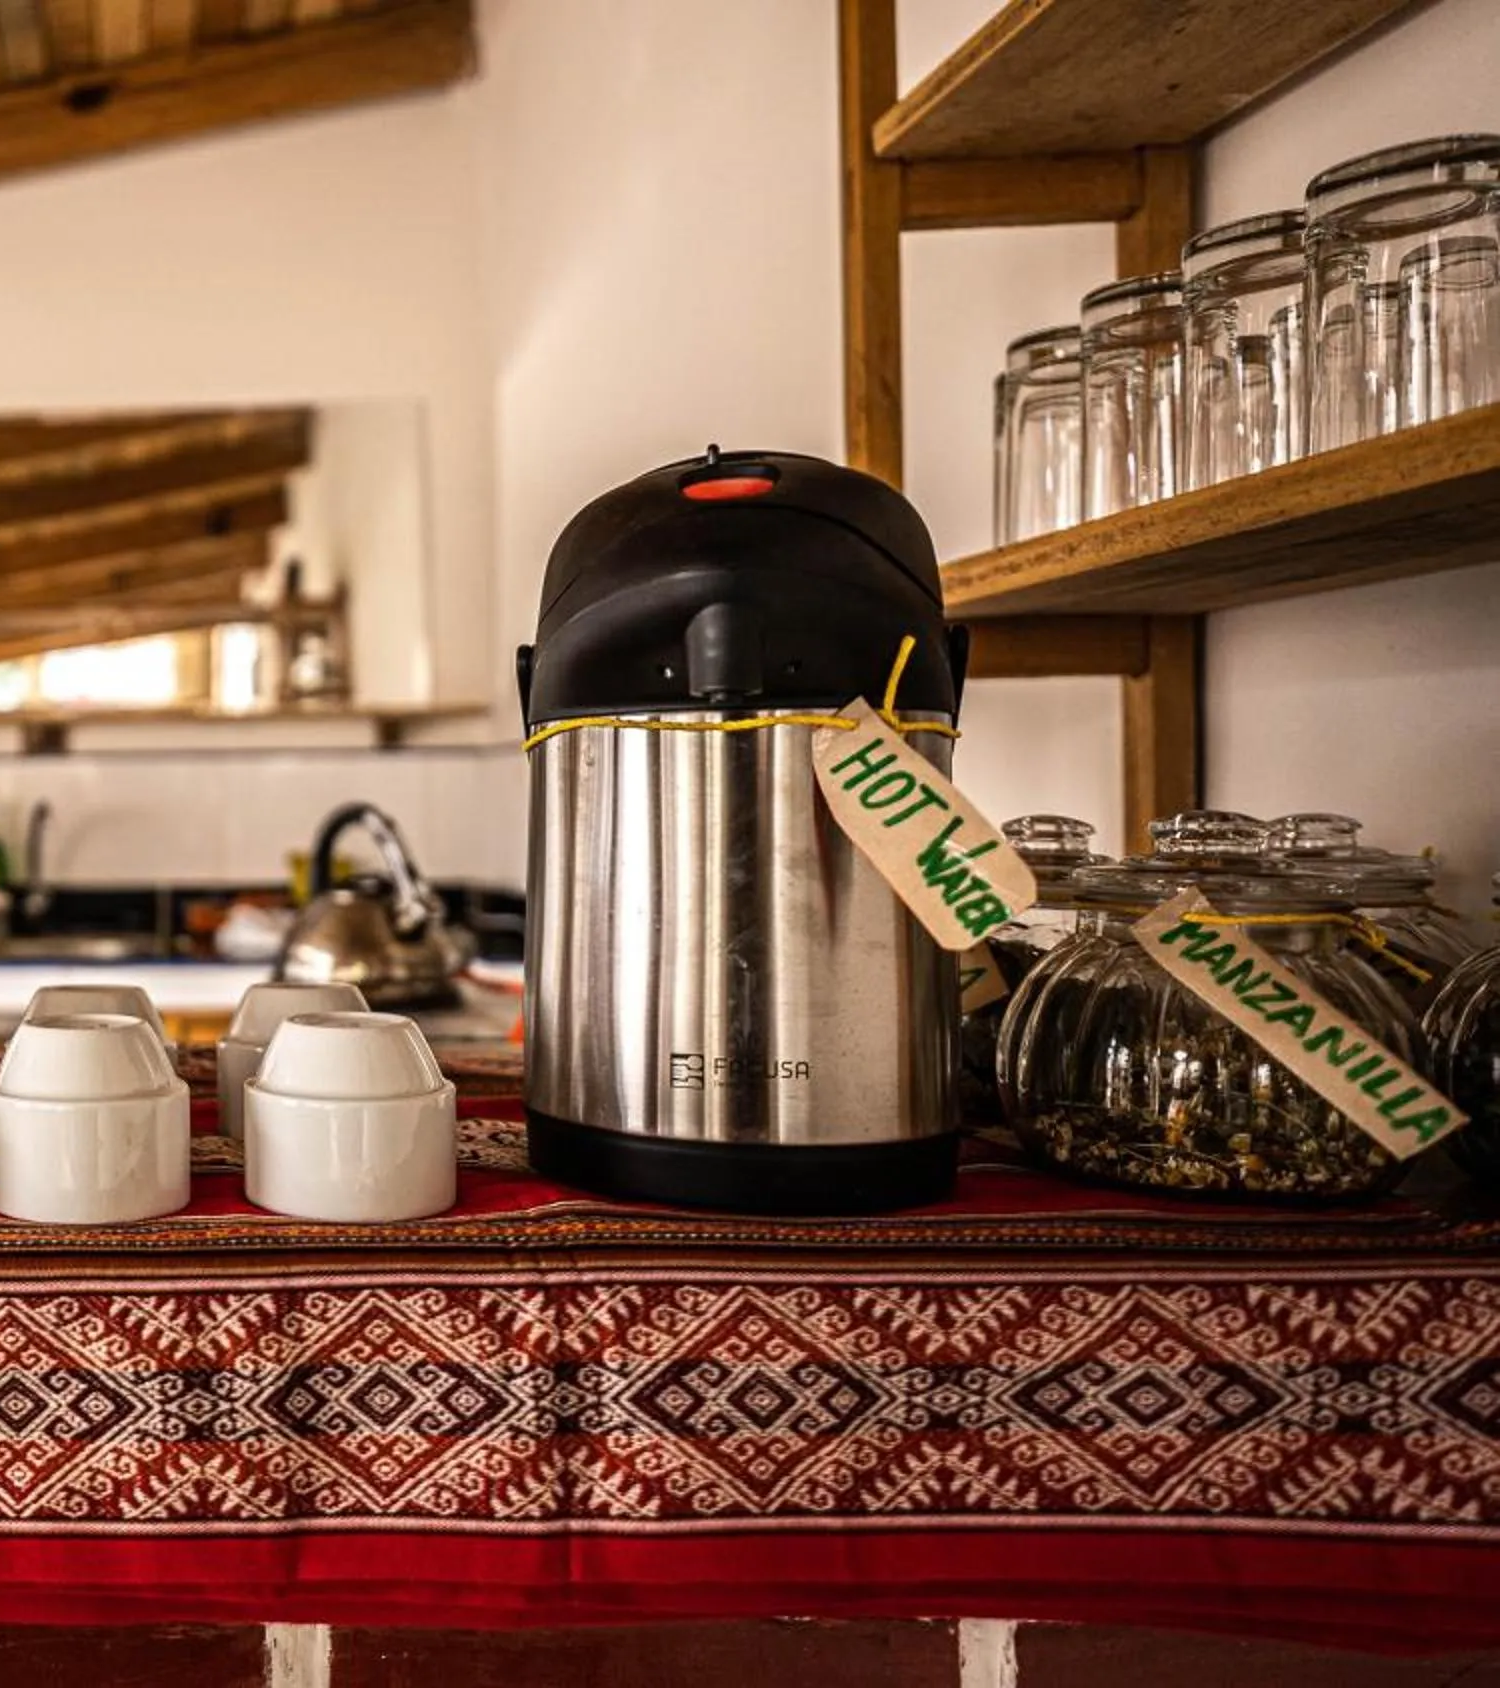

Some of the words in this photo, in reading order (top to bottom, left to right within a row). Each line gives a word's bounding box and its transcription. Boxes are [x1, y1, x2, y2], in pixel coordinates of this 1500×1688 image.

[830, 737, 949, 828] HOT
[916, 815, 1013, 937] WATER
[1159, 920, 1450, 1142] MANZANILLA
